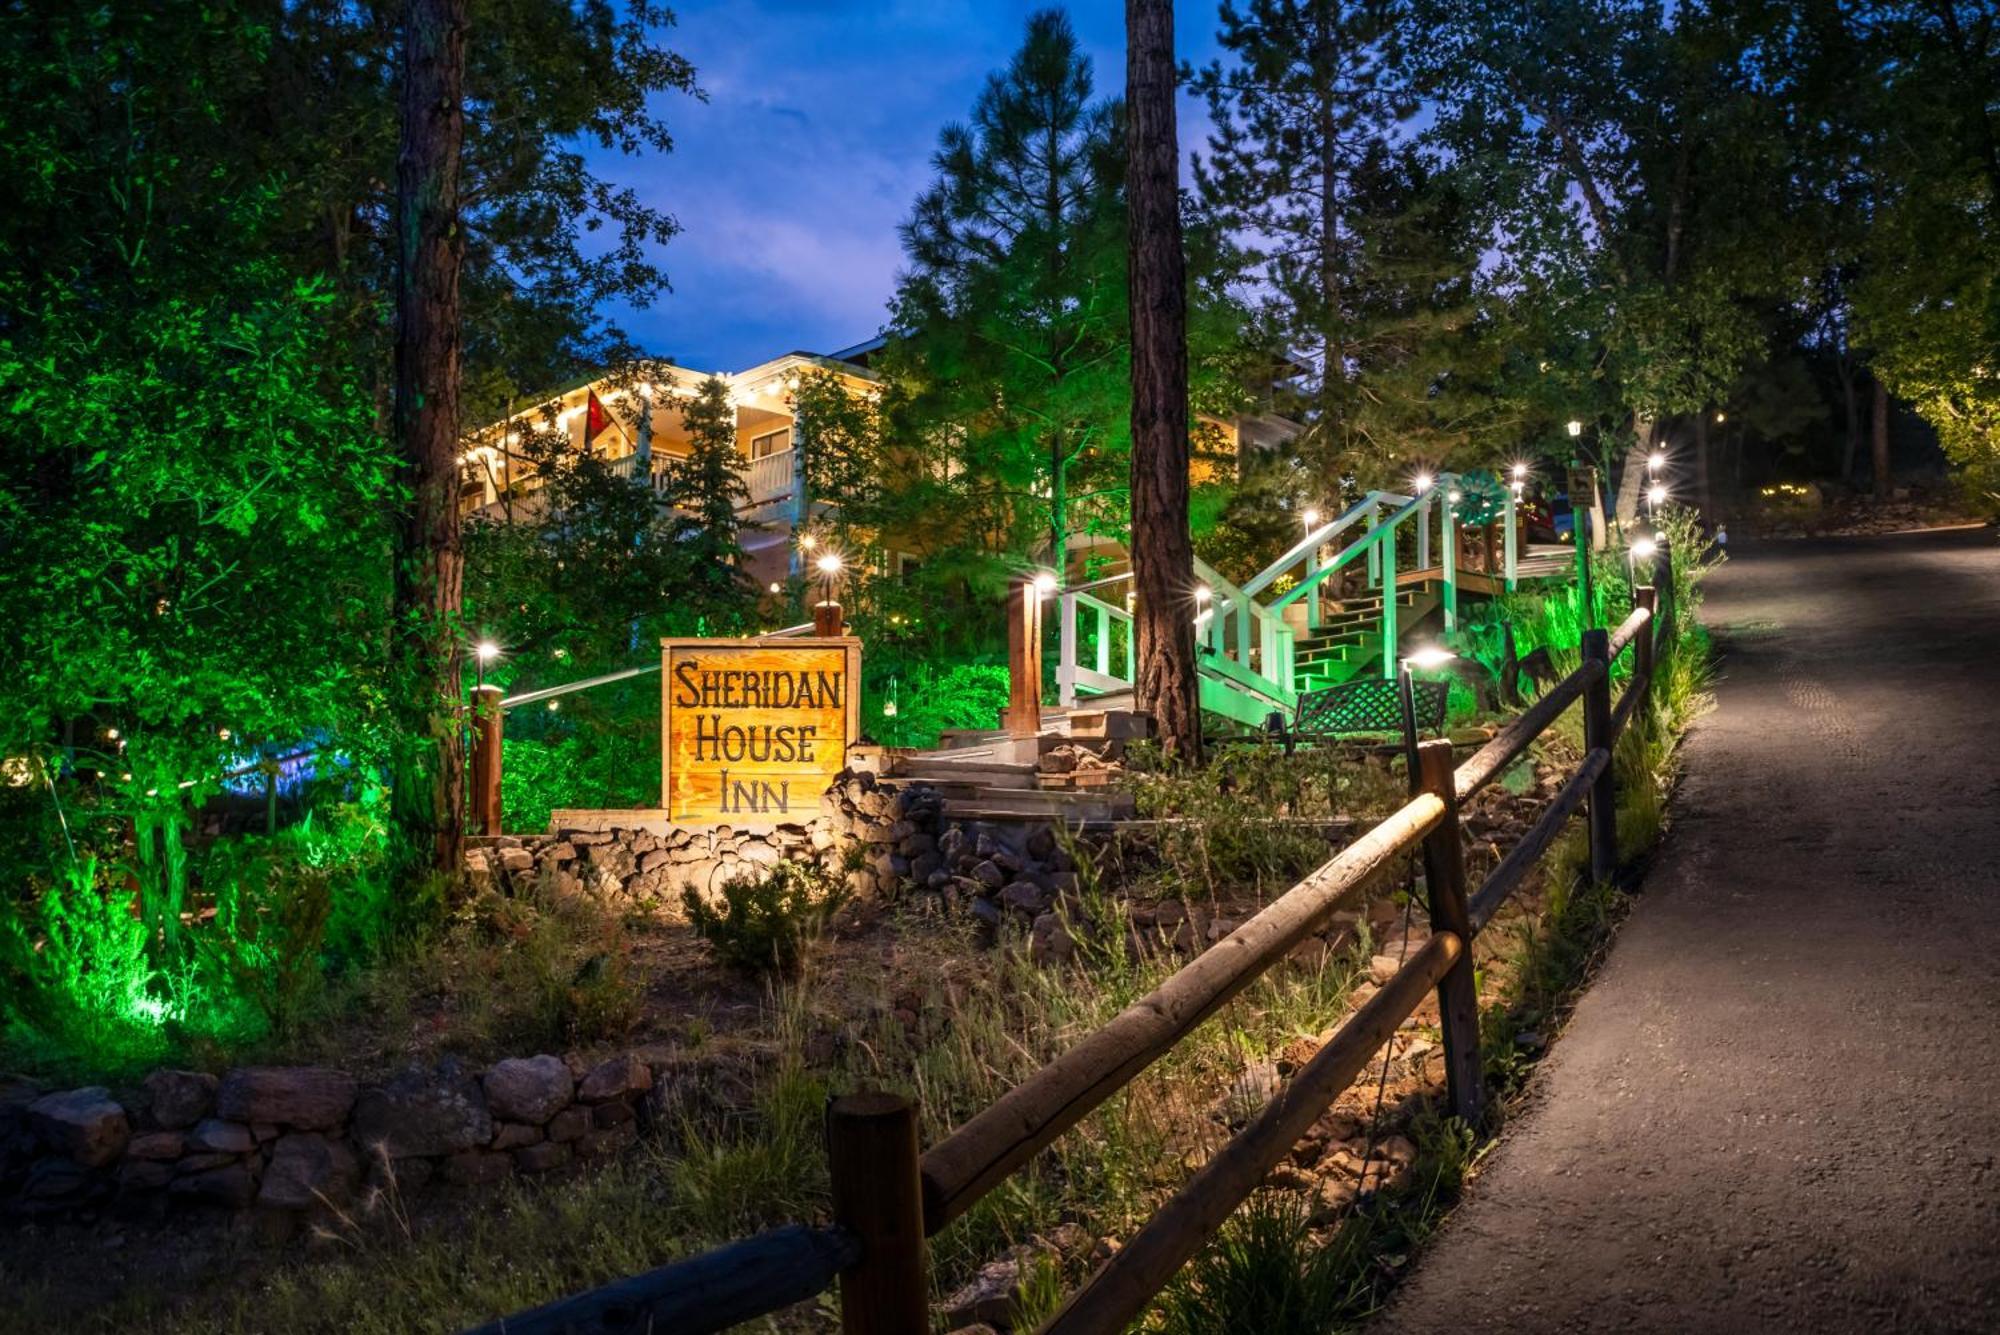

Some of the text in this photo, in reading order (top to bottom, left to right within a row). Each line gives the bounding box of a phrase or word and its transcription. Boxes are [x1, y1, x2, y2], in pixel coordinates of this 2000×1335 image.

[674, 661, 841, 708] SHERIDAN
[694, 714, 817, 762] HOUSE
[719, 768, 789, 813] INN
